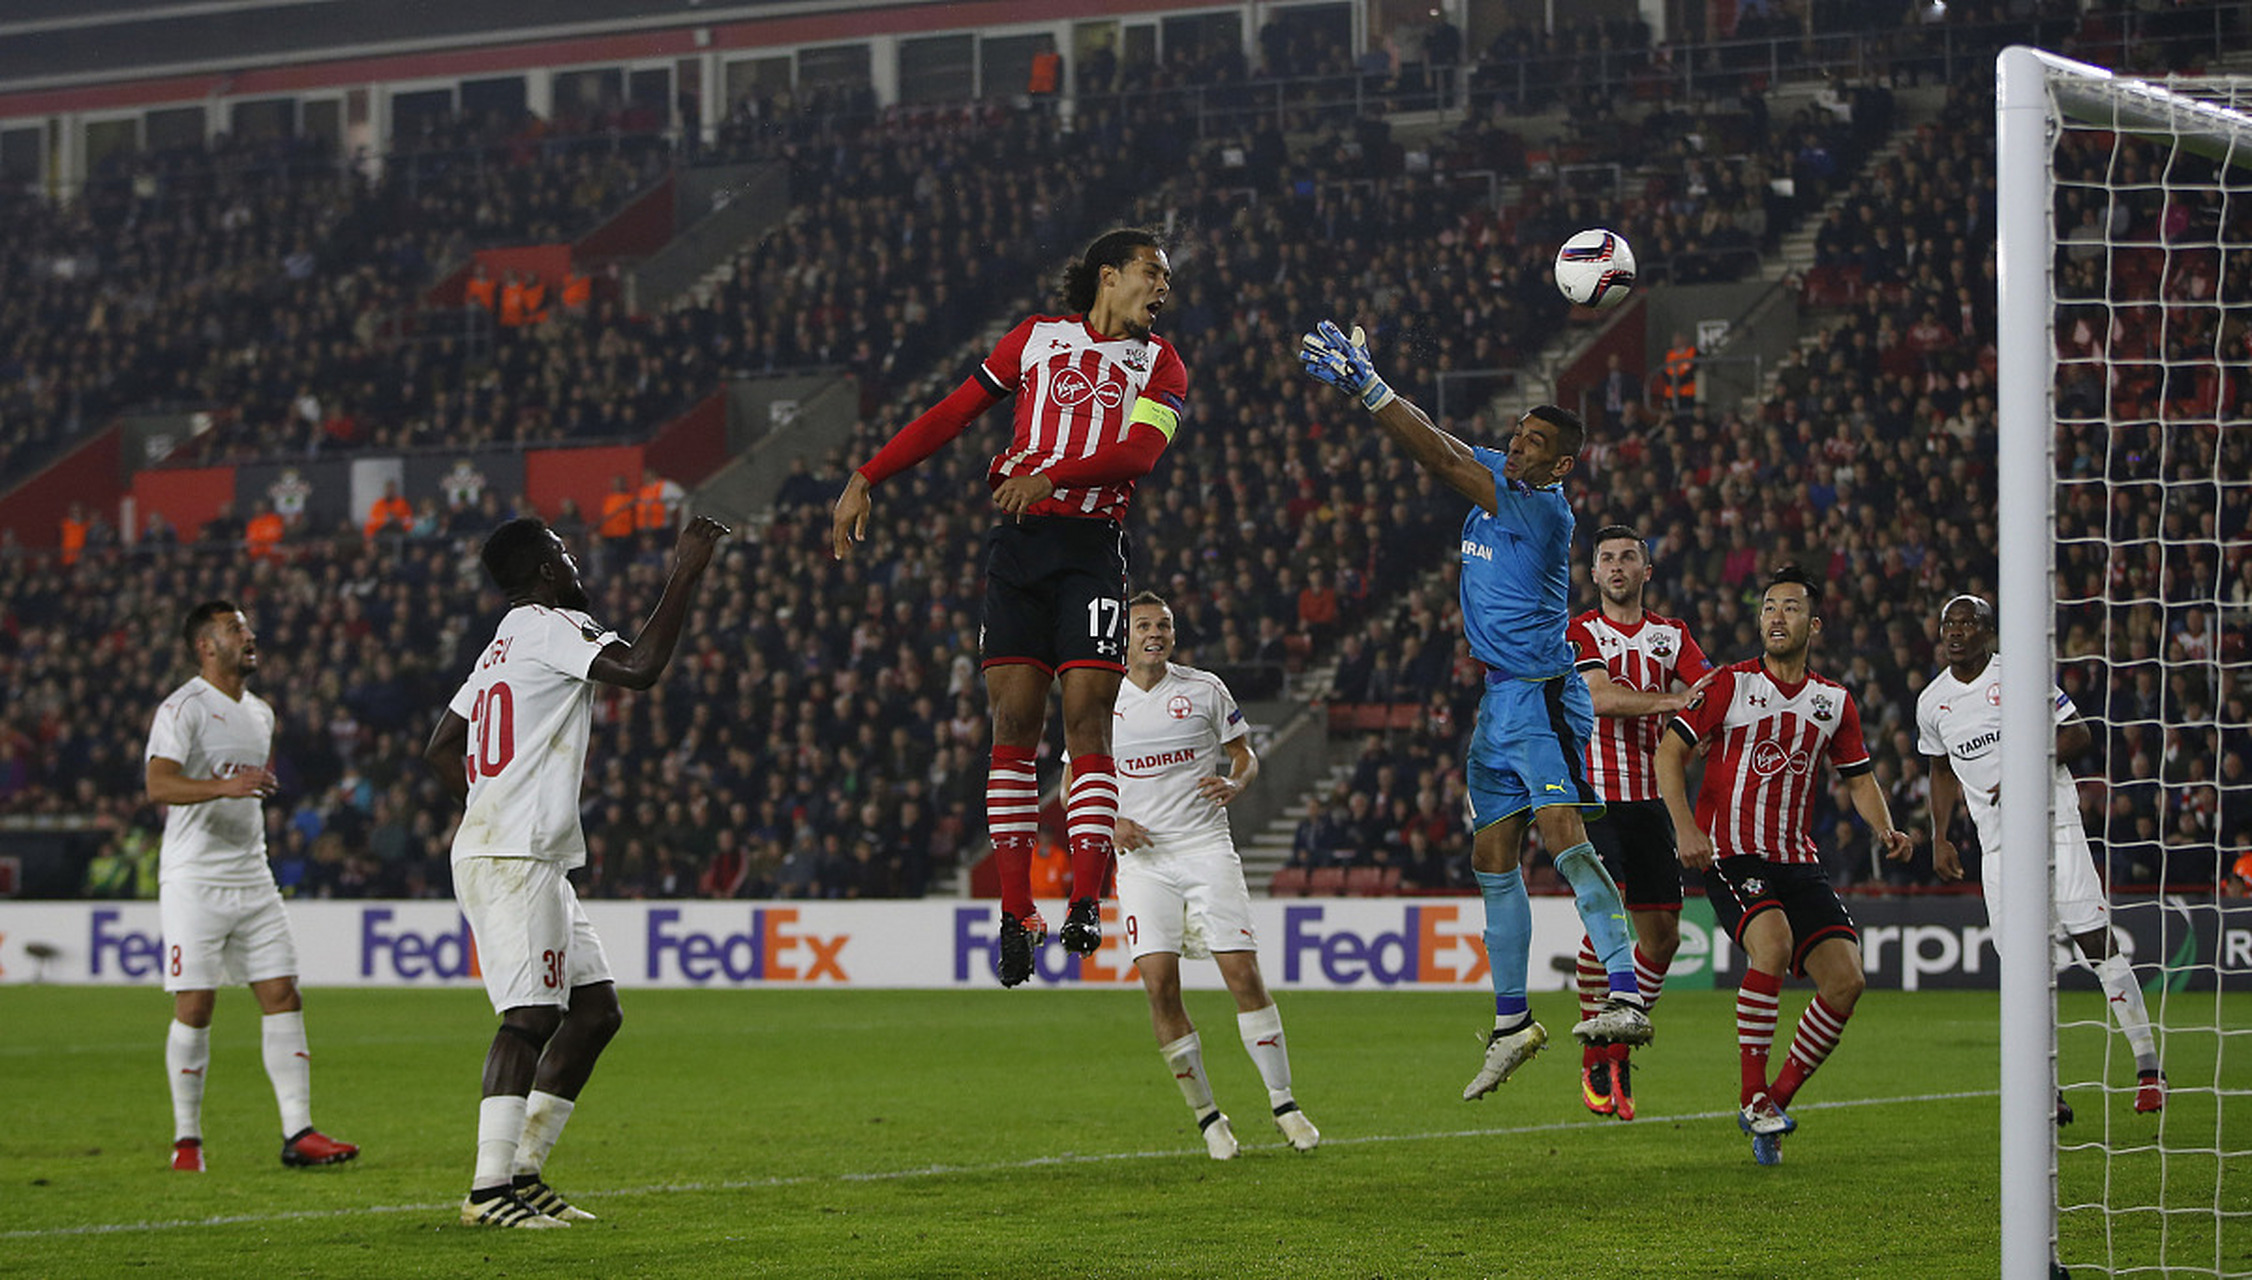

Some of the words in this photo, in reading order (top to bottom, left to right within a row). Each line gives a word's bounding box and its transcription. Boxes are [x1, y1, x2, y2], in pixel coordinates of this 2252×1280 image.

[1461, 540, 1493, 562] IRAN
[1087, 597, 1120, 638] 17
[467, 681, 515, 784] 30
[1957, 730, 2001, 755] TADIR
[1125, 748, 1196, 771] TADIRAN
[362, 909, 482, 979] Fed
[647, 908, 850, 982] FedEx
[954, 907, 1142, 983] FdE
[1125, 915, 1138, 945] 9
[1284, 905, 1491, 985] FedEx
[171, 944, 182, 977] 8
[542, 949, 567, 988] 30
